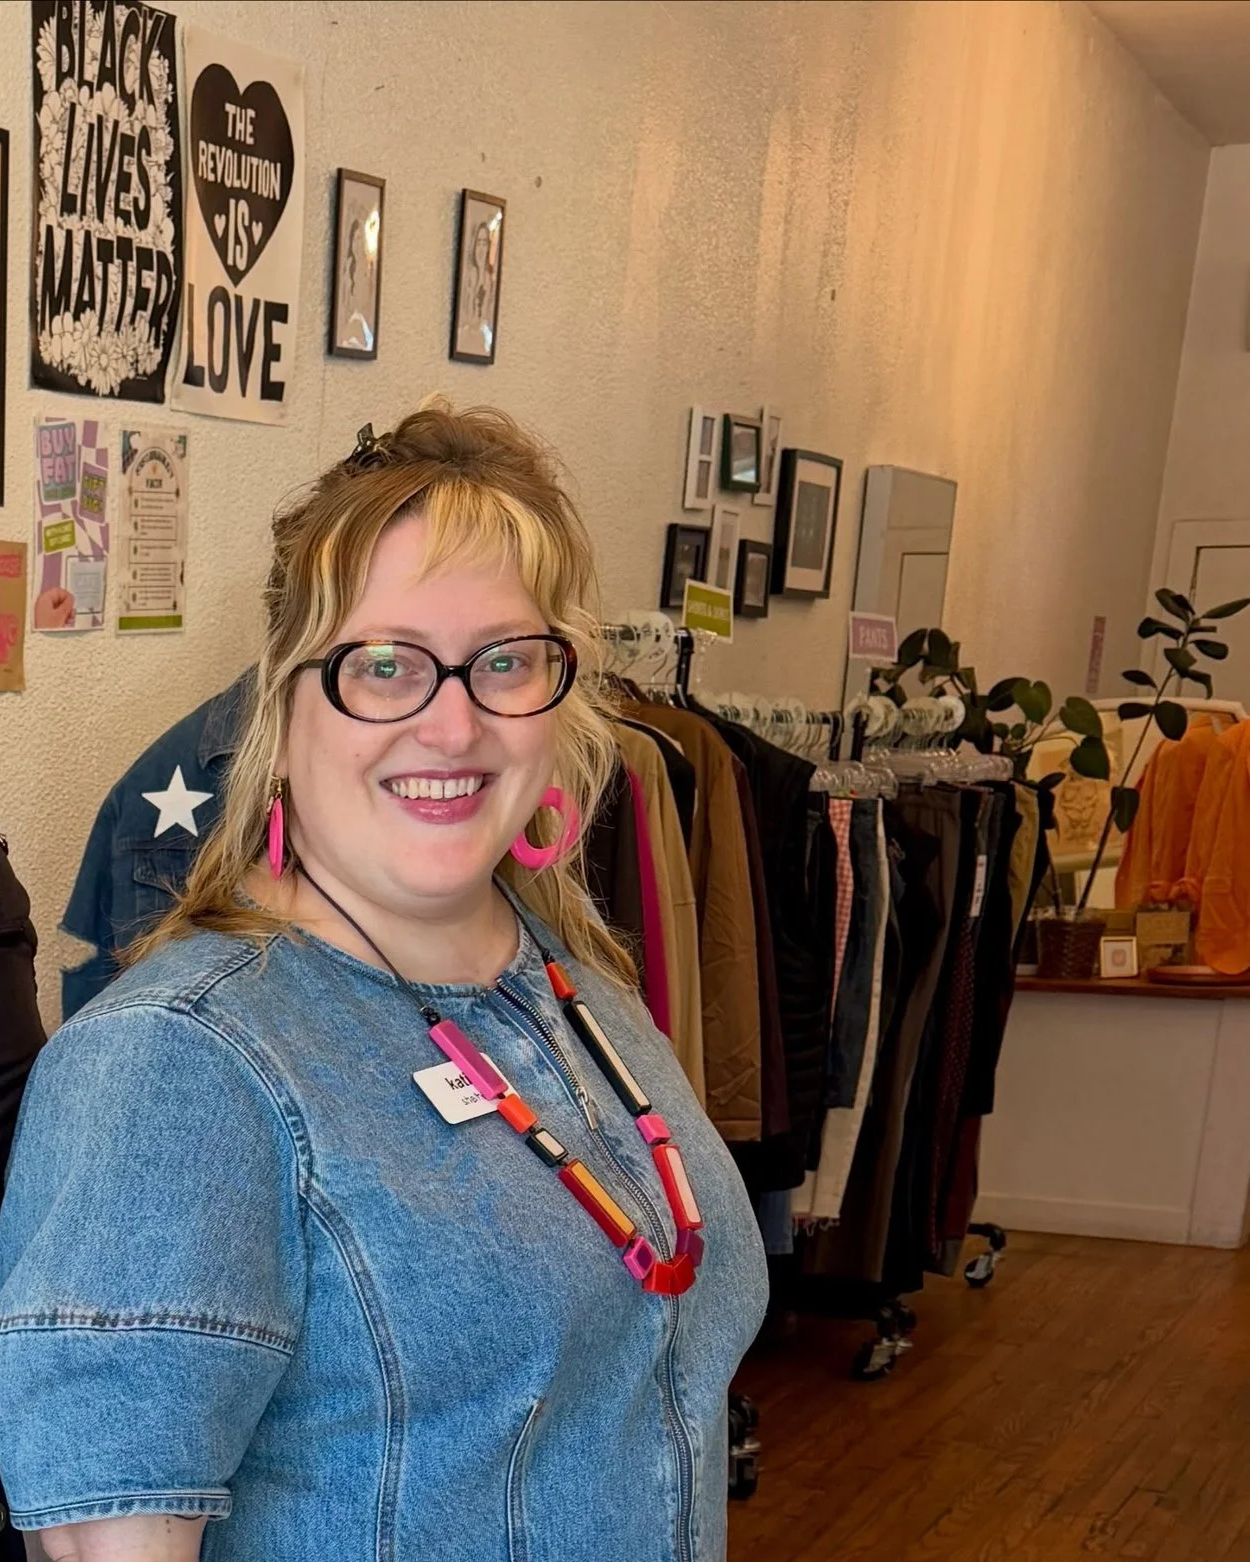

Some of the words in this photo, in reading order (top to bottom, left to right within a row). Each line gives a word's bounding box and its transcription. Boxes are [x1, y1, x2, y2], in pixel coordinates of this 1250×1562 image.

[55, 0, 166, 118] BLACK
[59, 101, 152, 231] LIVES
[199, 140, 282, 201] REVOLUTION
[225, 102, 256, 145] THE
[227, 198, 250, 272] IS
[40, 224, 172, 349] MATTER
[182, 282, 289, 402] LOVE
[40, 426, 75, 456] BUY
